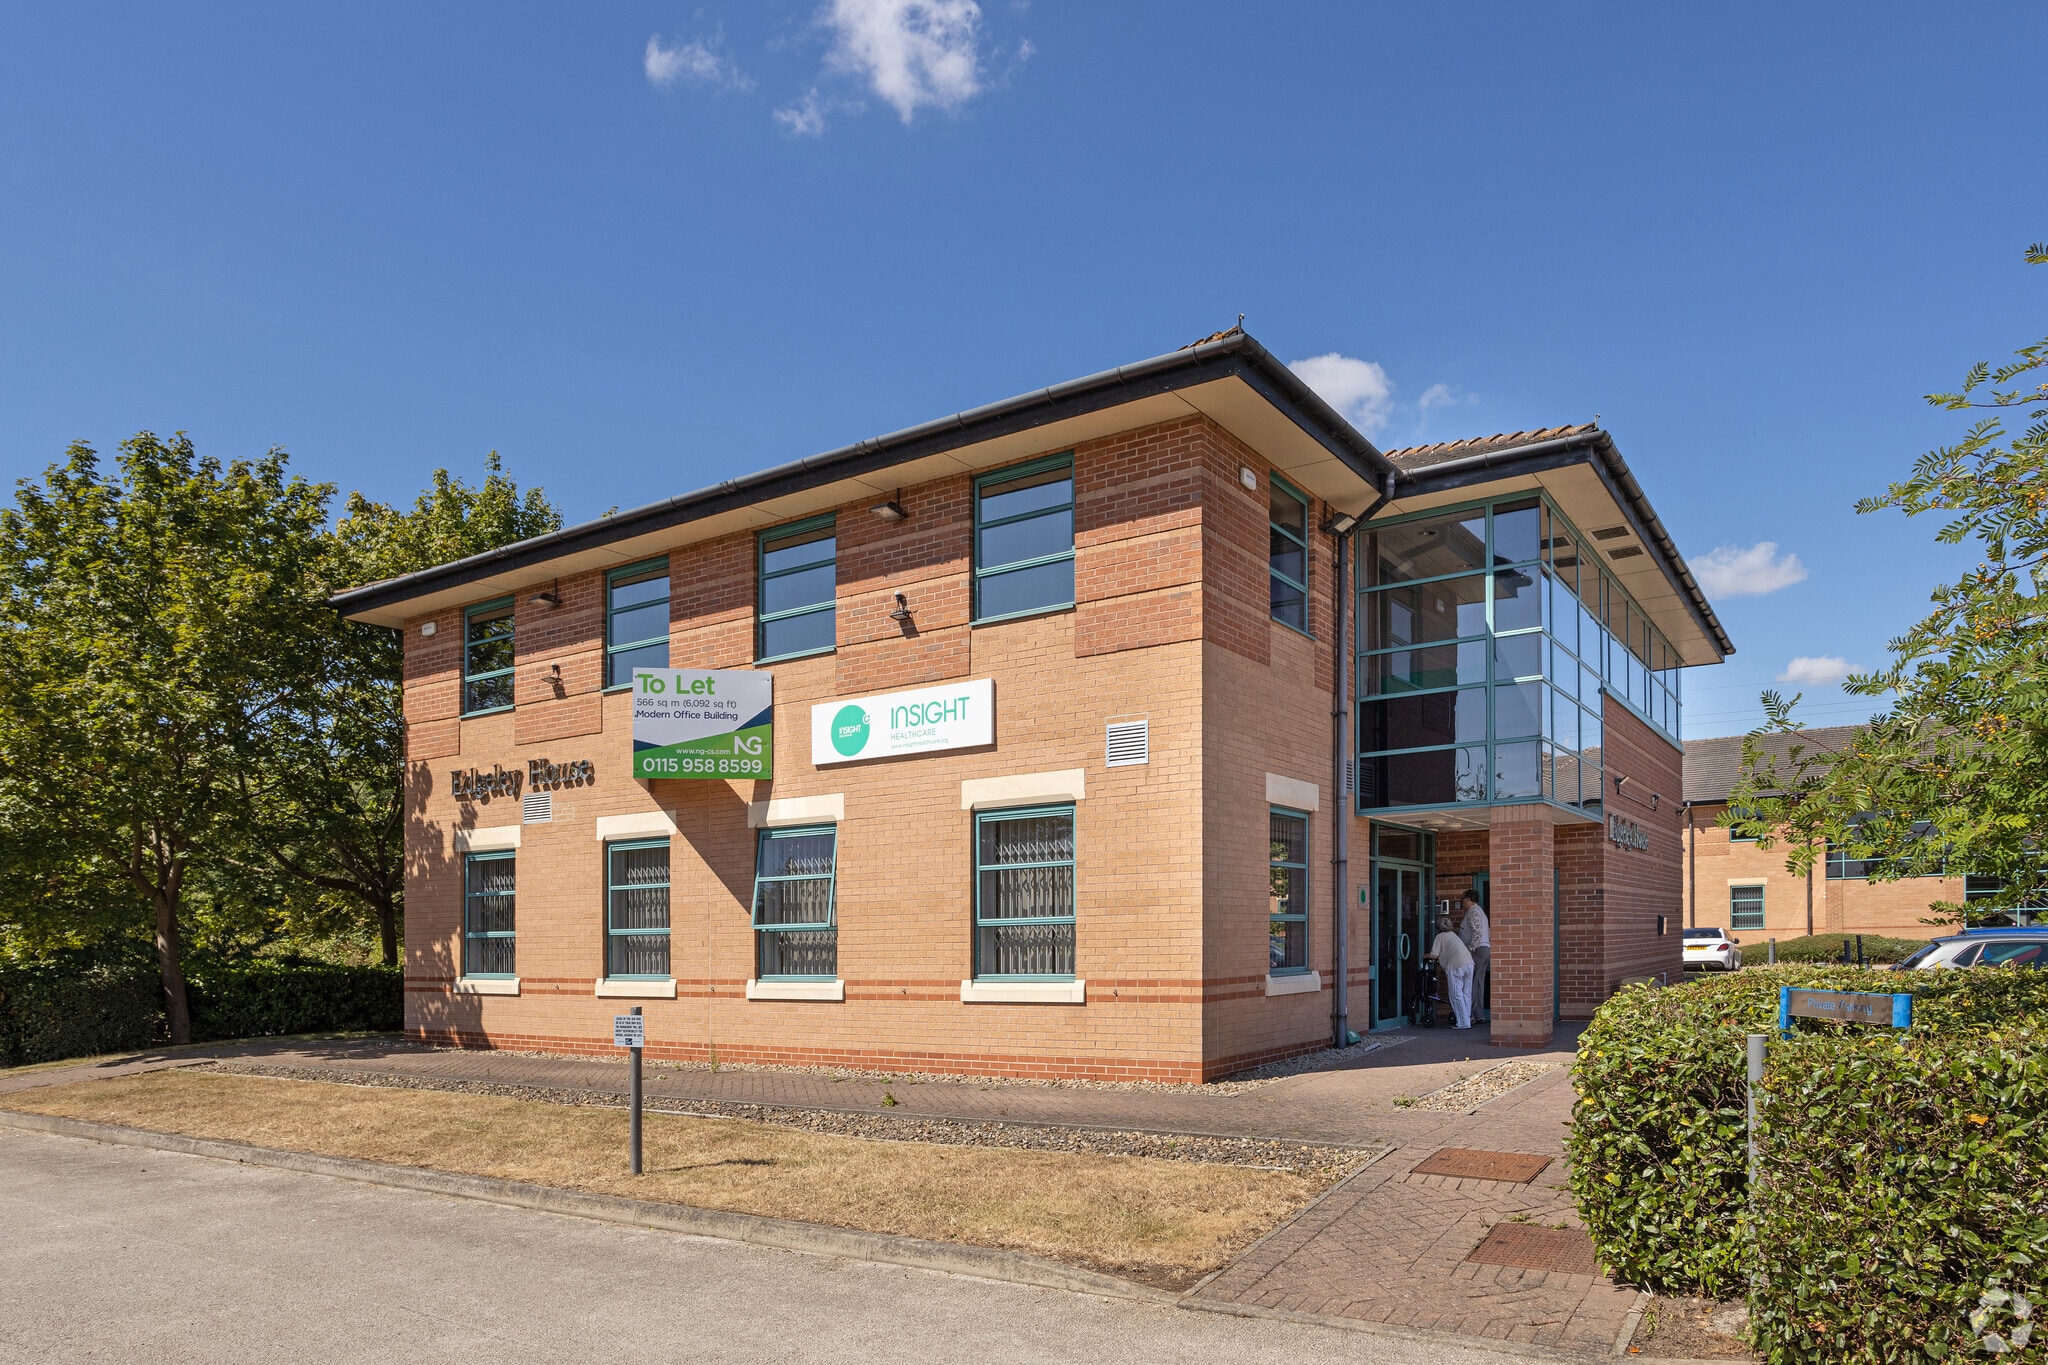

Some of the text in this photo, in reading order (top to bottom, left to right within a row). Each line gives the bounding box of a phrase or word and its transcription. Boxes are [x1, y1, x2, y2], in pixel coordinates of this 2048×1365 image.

[637, 673, 716, 696] To Let
[636, 698, 654, 707] 566
[656, 700, 668, 708] sq
[683, 699, 710, 708] (6,092
[713, 700, 724, 709] sq
[726, 700, 737, 709] ft)
[636, 710, 739, 721] Modern Office Building
[891, 696, 970, 730] INSIGHT
[890, 727, 937, 741] HEALTHCARE
[675, 747, 731, 756] www.ng-cs.com
[733, 735, 763, 756] NG
[642, 757, 763, 774] 0115 958 8599
[450, 758, 592, 800] Edgeley House
[1807, 997, 1836, 1011] Private
